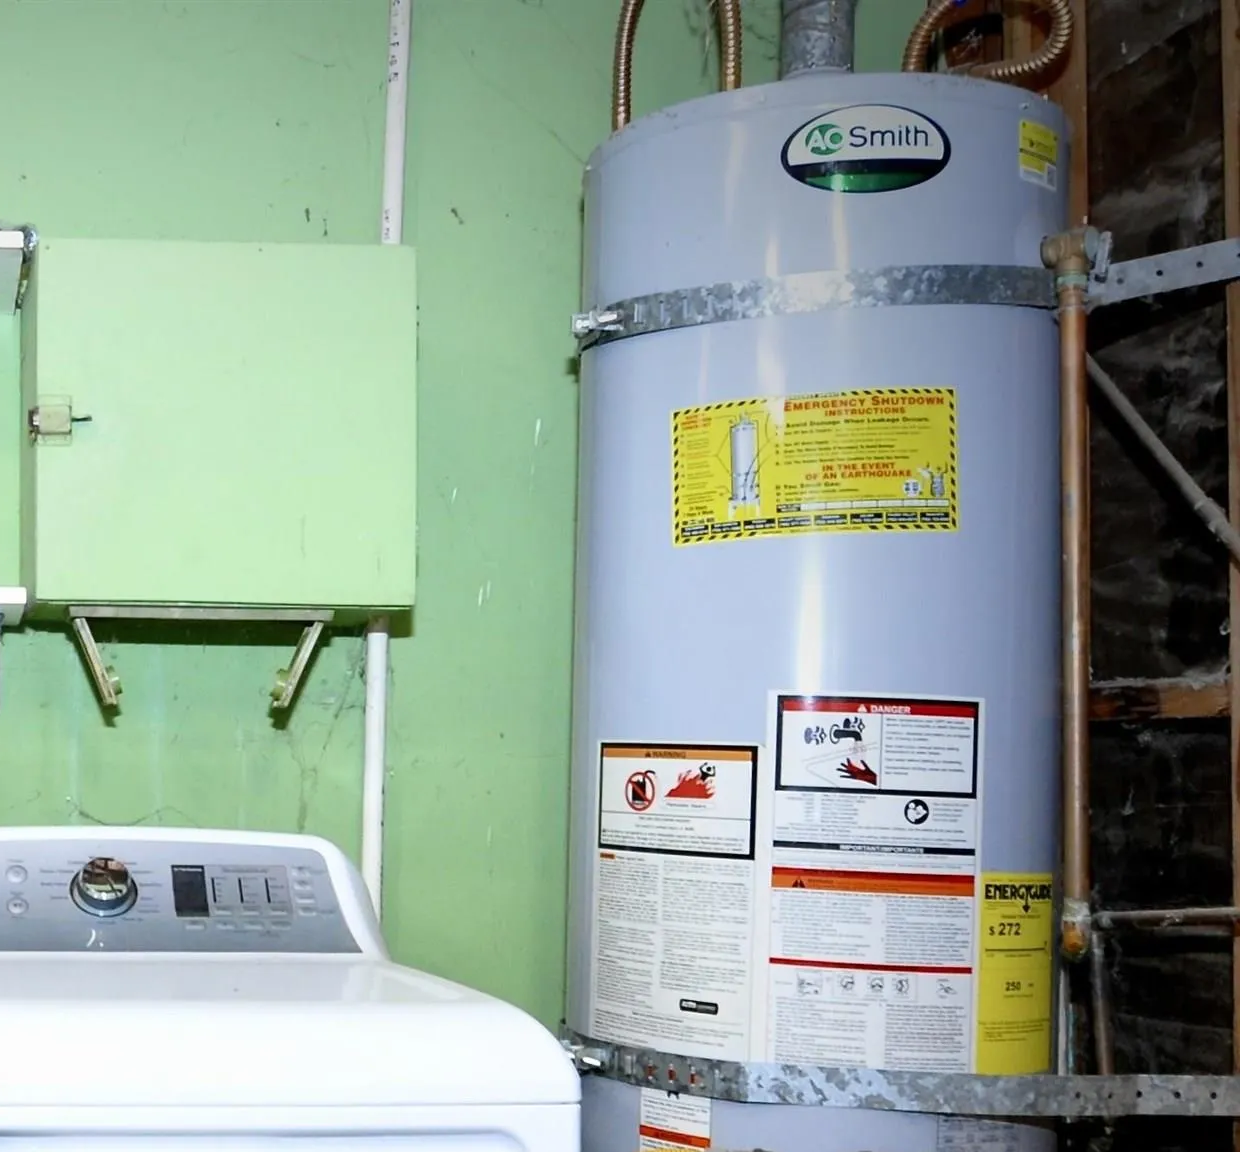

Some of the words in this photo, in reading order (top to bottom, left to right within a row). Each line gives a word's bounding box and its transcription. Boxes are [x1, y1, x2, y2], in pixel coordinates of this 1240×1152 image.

[849, 124, 929, 148] Smith
[784, 398, 867, 413] EMERGENCY
[871, 395, 944, 407] SHUTDOWN
[825, 407, 906, 417] INSTRUCTIONS
[838, 463, 858, 471] THE
[861, 461, 896, 470] EVENT
[823, 472, 837, 480] AN
[841, 470, 913, 479] EARTHQUAKE
[870, 704, 911, 714] DANGER
